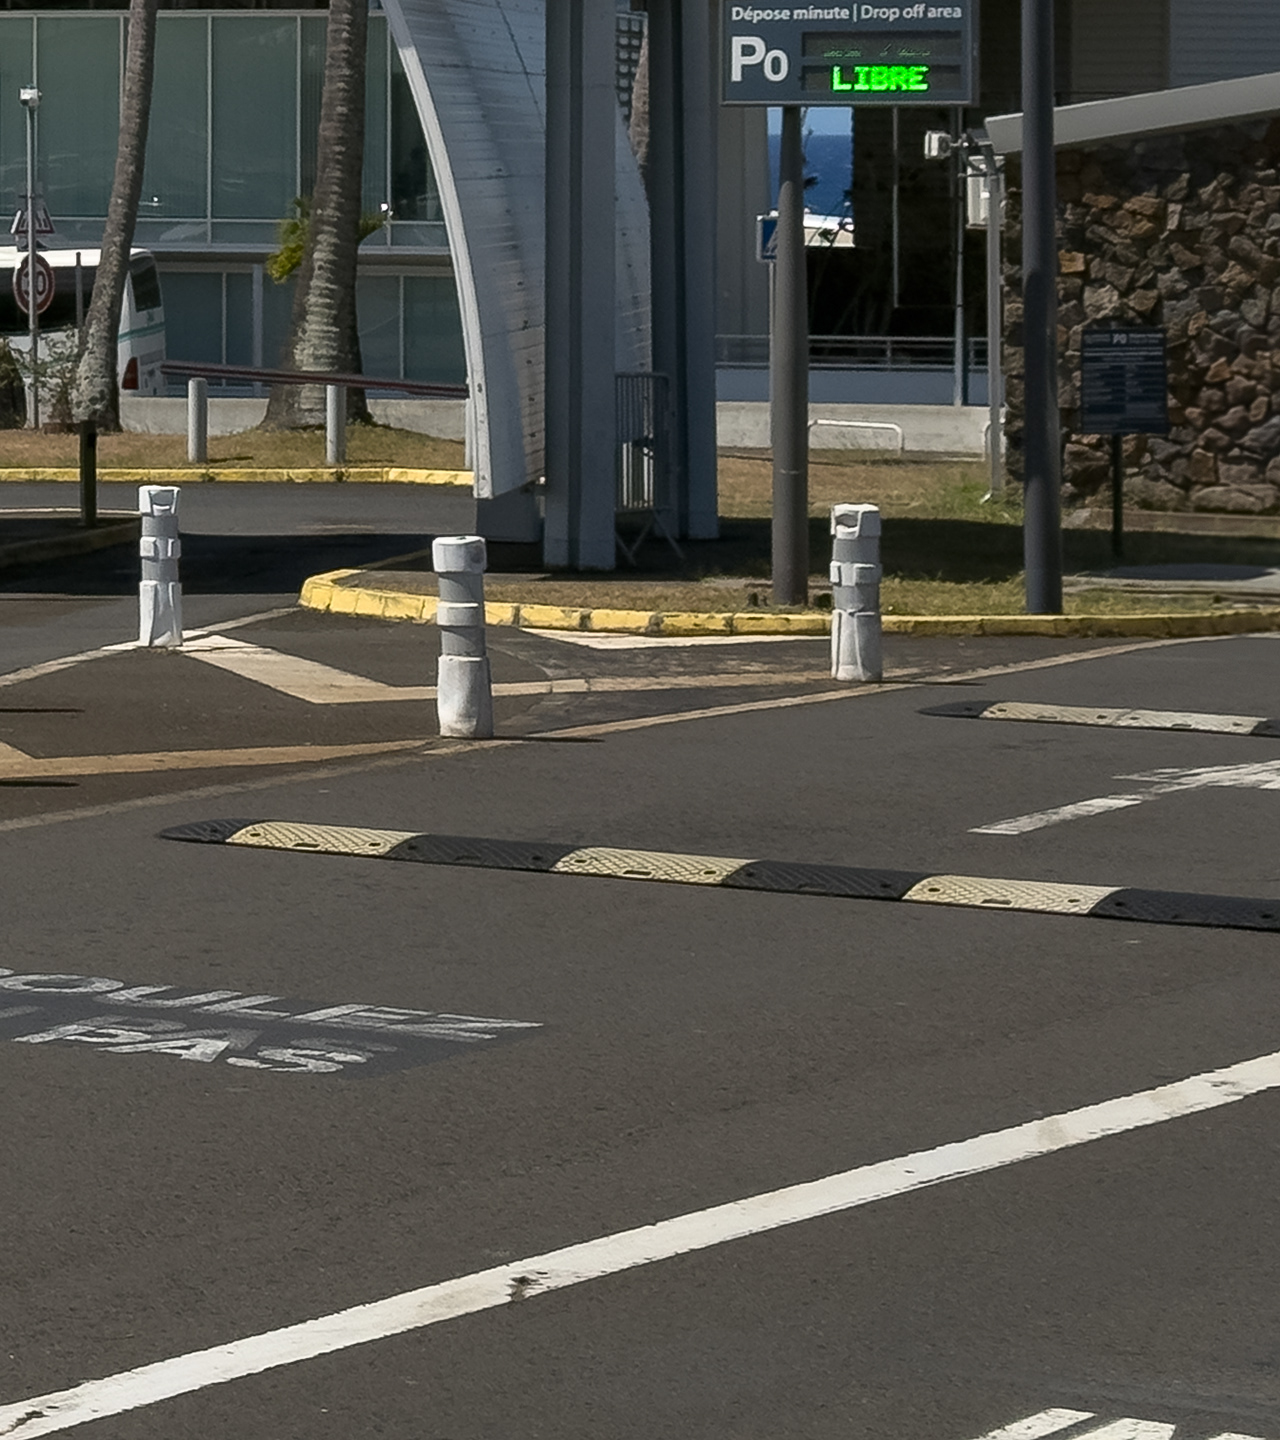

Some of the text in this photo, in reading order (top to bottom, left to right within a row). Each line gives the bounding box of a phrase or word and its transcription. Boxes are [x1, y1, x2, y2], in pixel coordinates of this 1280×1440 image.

[731, 6, 792, 24] Dépose
[860, 5, 901, 23] Drop
[902, 2, 926, 19] off
[927, 6, 963, 19] area
[831, 65, 930, 91] LIBRE
[11, 1020, 380, 1074] PAS
